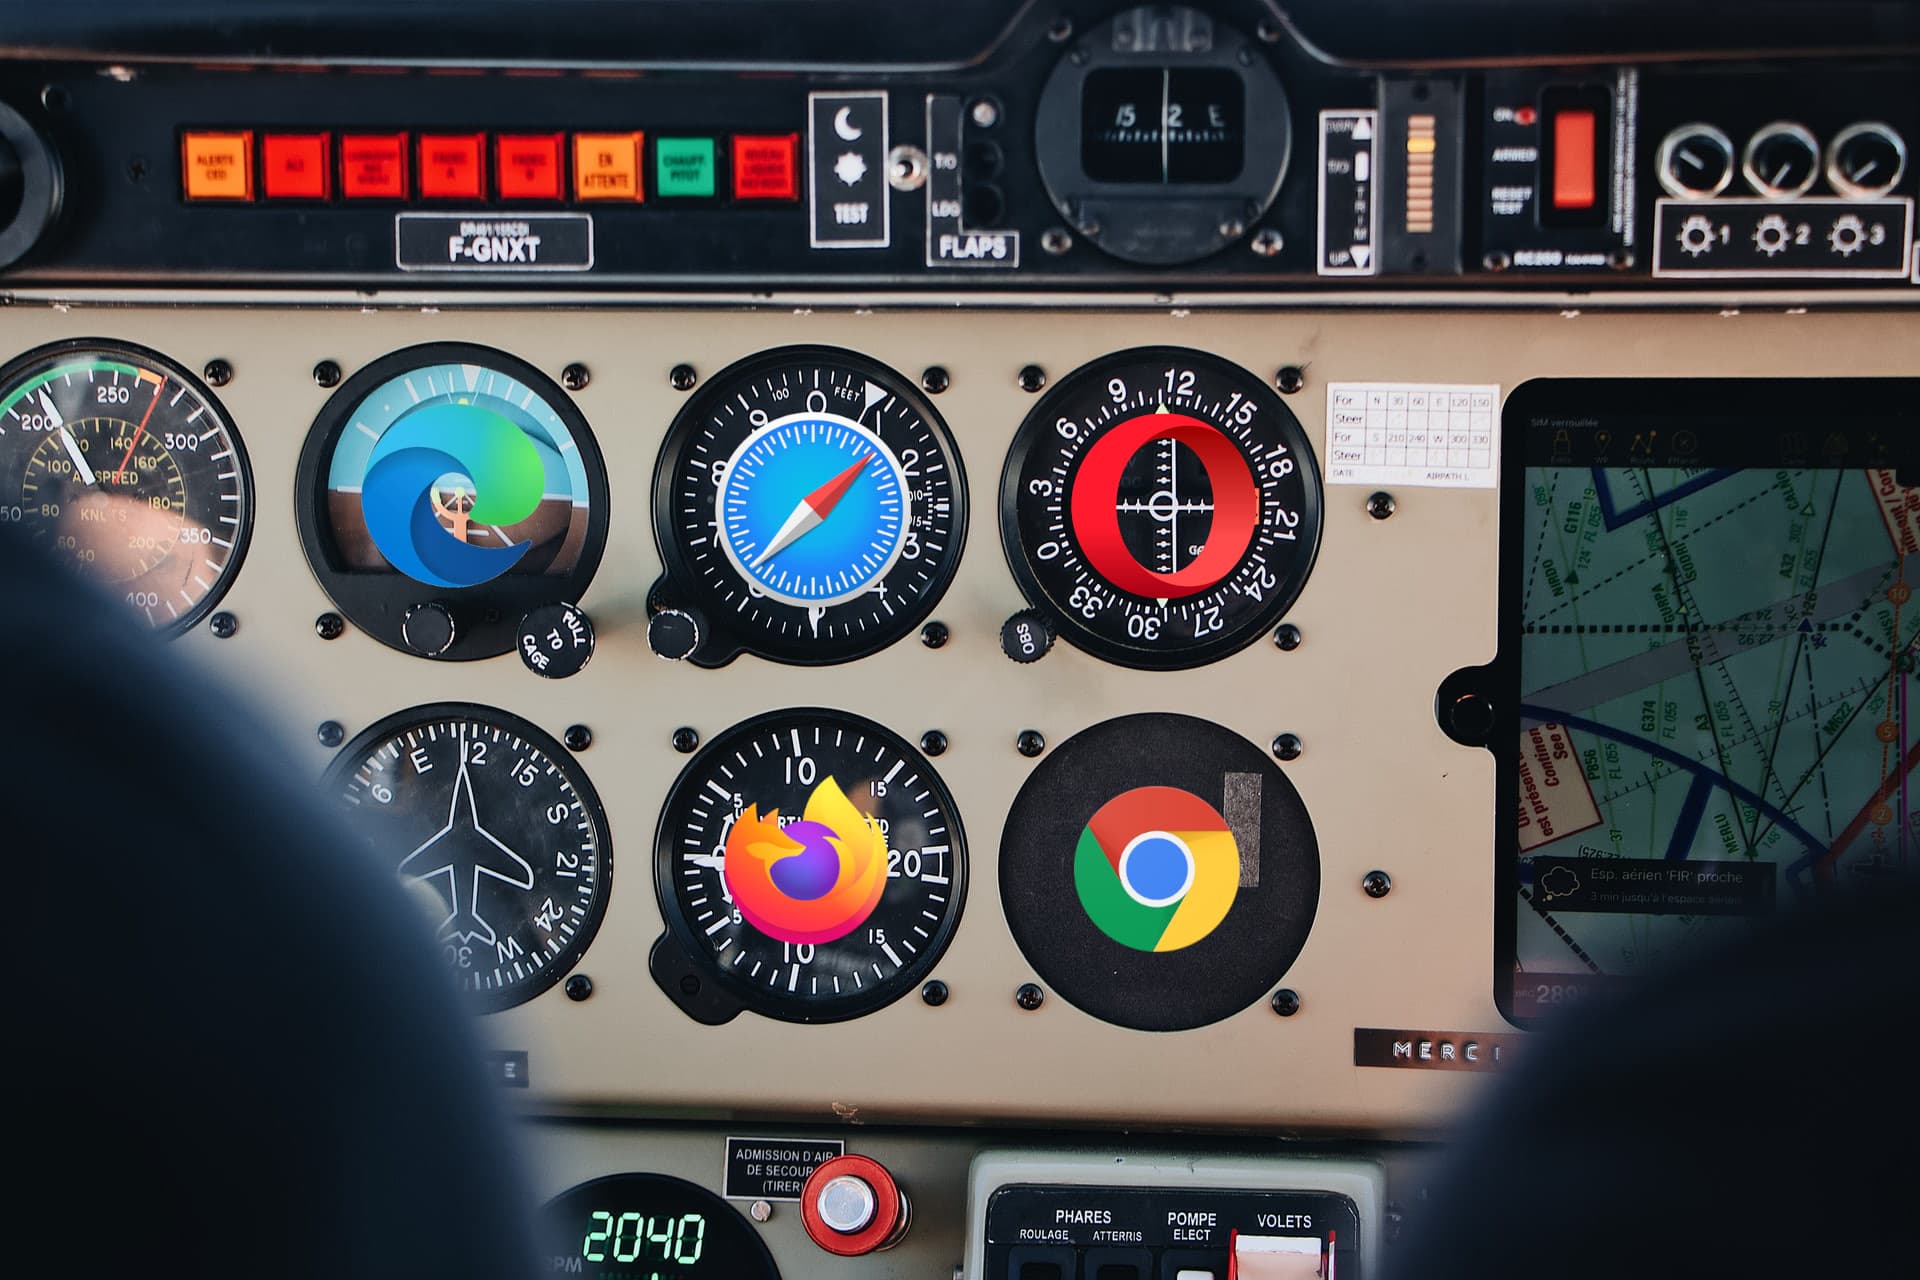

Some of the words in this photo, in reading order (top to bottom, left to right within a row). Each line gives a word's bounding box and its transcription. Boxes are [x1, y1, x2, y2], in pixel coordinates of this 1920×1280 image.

[582, 173, 630, 188] ATTENTE
[833, 202, 869, 224] TEST
[1719, 223, 1731, 246] 1
[1794, 223, 1812, 246] 2
[1869, 223, 1886, 246] 3
[449, 235, 541, 263] F-GNXT
[939, 235, 1007, 259] FLAPS
[1108, 378, 1127, 404] 9
[1164, 368, 1197, 397] 12
[97, 387, 130, 404] 250
[771, 387, 790, 402] 100
[806, 390, 827, 413] 0
[834, 386, 861, 402] FEET
[1335, 395, 1353, 405] For
[1412, 398, 1424, 406] 60
[1452, 398, 1469, 407] 120
[1225, 392, 1259, 426] 15
[1335, 414, 1363, 424] Steer
[21, 414, 56, 432] 200
[1055, 417, 1079, 440] 6
[109, 437, 134, 450] 140
[164, 433, 199, 451] 300
[1334, 432, 1352, 442] For
[1388, 433, 1405, 442] 210
[1408, 433, 1426, 442] 240
[1451, 435, 1468, 443] 300
[133, 456, 158, 470] 160
[901, 449, 921, 477] 2
[1265, 443, 1294, 479] 18
[1334, 450, 1361, 461] Steer
[47, 461, 72, 474] 100
[1029, 479, 1053, 497] 3
[0, 506, 22, 522] 50
[41, 504, 60, 517] 80
[148, 496, 171, 511] 180
[1273, 510, 1300, 542] 21
[1564, 501, 1583, 534] G116
[57, 536, 76, 549] 60
[128, 536, 157, 550] 200
[179, 528, 212, 545] 350
[902, 532, 921, 560] 3
[1584, 529, 1598, 544] FL
[76, 549, 95, 562] 40
[1036, 541, 1060, 561] 0
[1779, 554, 1796, 578] A32
[1243, 565, 1276, 603] 24
[127, 592, 159, 607] 400
[1068, 585, 1104, 620] 33
[561, 610, 586, 648] PULL
[1127, 613, 1161, 641] 30
[1193, 605, 1225, 639] 27
[546, 628, 565, 651] TO
[1016, 622, 1036, 655] OBS
[522, 634, 551, 670] CAGE
[1641, 700, 1657, 732] G374
[1662, 726, 1676, 741] FL
[463, 741, 488, 766] 12
[1551, 733, 1569, 760] See
[409, 747, 433, 775] E
[510, 757, 540, 787] 15
[784, 756, 817, 786] 10
[1584, 748, 1602, 781] P856
[1609, 766, 1623, 780] FL
[870, 780, 887, 798] 15
[732, 793, 744, 809] 5
[546, 802, 570, 825] S
[1536, 815, 1555, 837] est
[1714, 814, 1740, 854] MERLU
[555, 850, 579, 879] 21
[887, 850, 922, 879] 20
[1591, 867, 1618, 882] Esp.
[1622, 867, 1663, 881] aérien
[1697, 870, 1744, 886] proche
[1600, 893, 1620, 903] min
[533, 897, 564, 932] 24
[732, 909, 744, 925] 5
[868, 928, 886, 946] 15
[496, 935, 525, 964] W
[784, 941, 815, 965] 10
[735, 1147, 800, 1162] ADMISSION
[747, 1163, 762, 1176] DE
[765, 1164, 814, 1177] SECOUR
[1055, 1210, 1112, 1226] PHARES
[1167, 1212, 1217, 1228] POMPE
[1257, 1213, 1313, 1230] VOLETS
[583, 1210, 706, 1265] 2040
[1019, 1229, 1070, 1242] ROULAGE
[1092, 1229, 1143, 1243] ATTERRIS
[1173, 1229, 1211, 1243] ELECT
